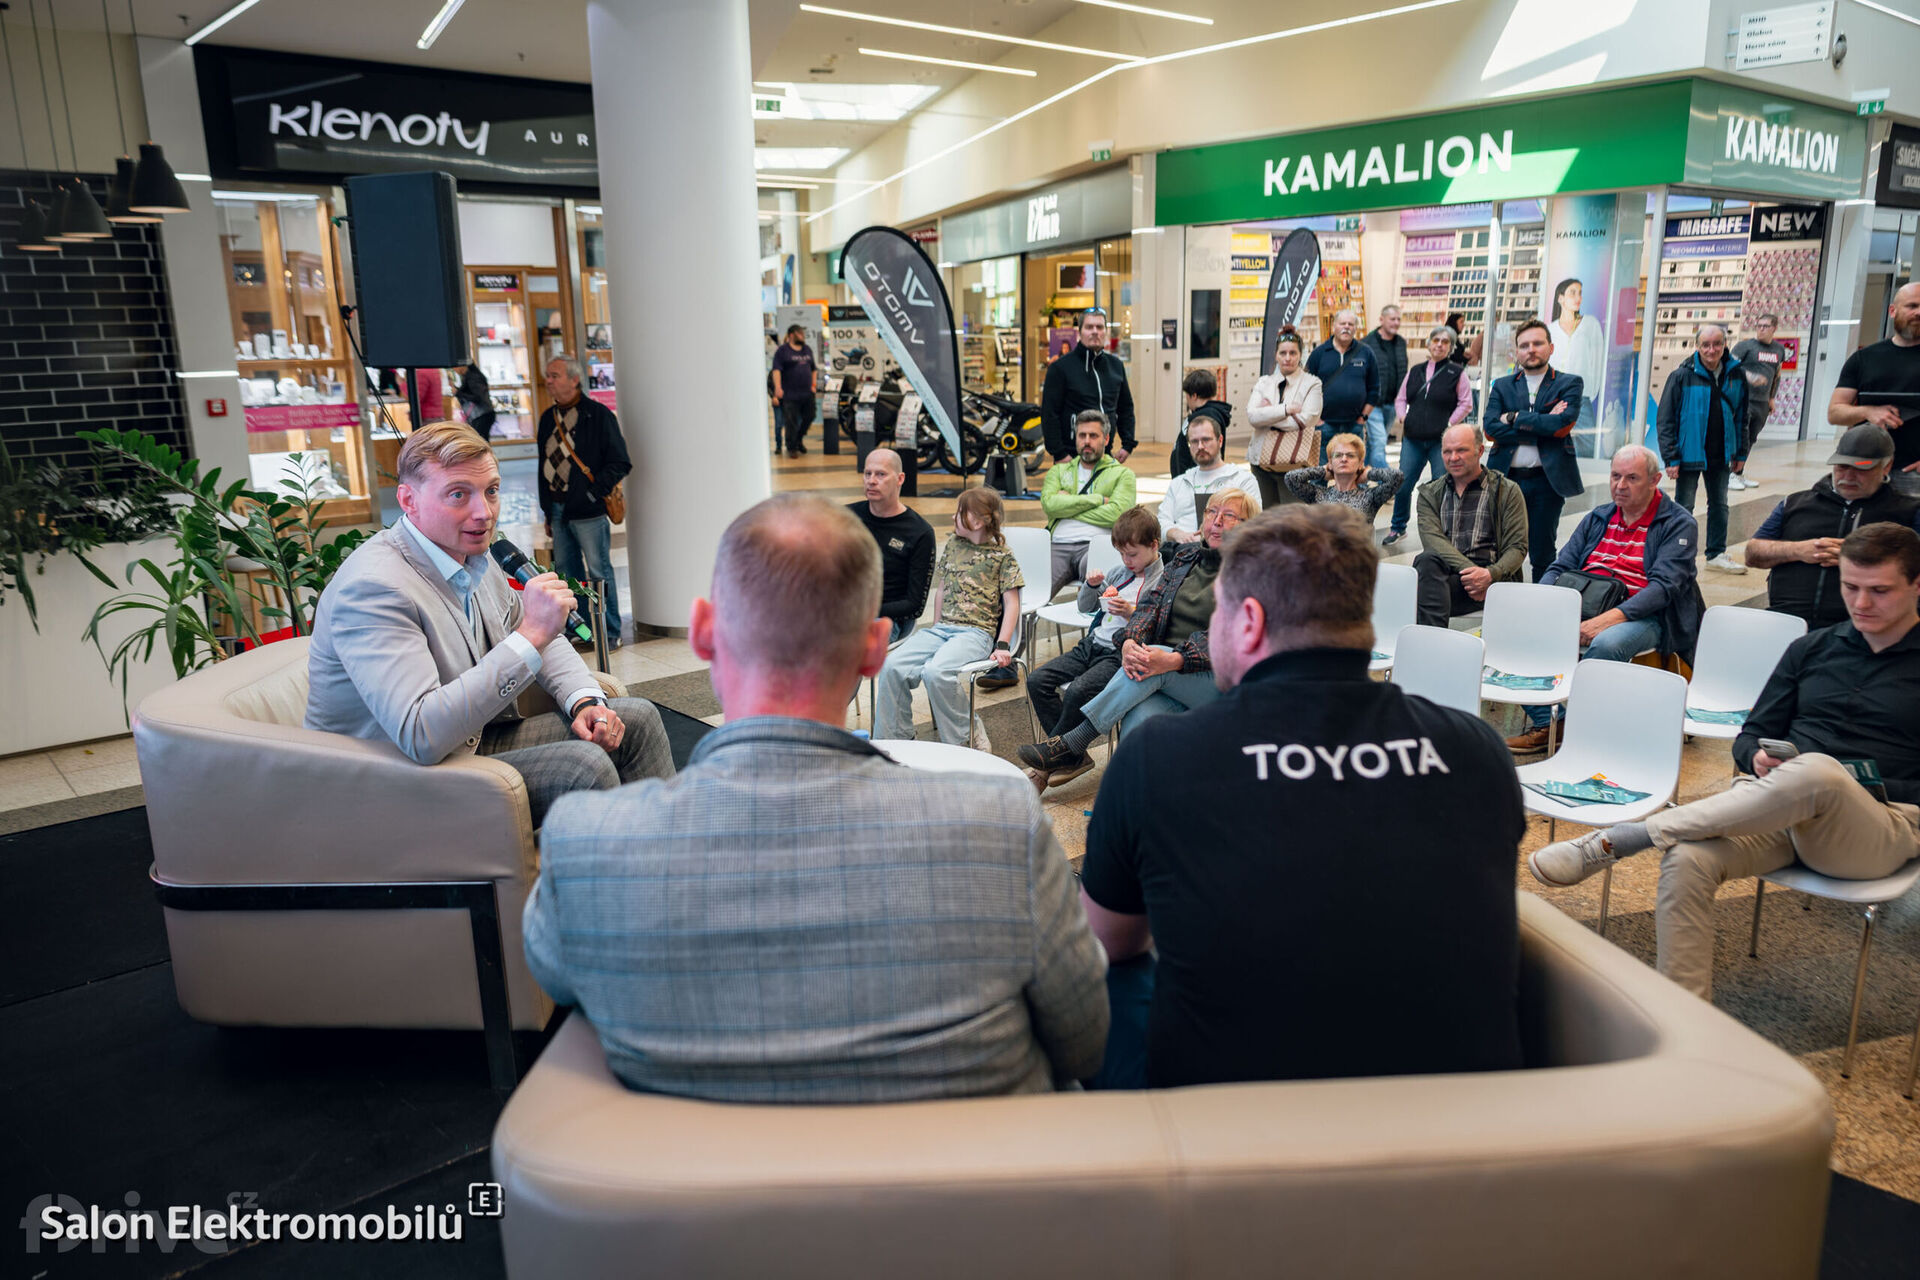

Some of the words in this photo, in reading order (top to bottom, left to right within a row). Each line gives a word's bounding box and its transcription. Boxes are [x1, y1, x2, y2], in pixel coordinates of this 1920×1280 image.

[1725, 116, 1839, 173] KAMALION
[1264, 129, 1514, 196] KAMALION
[1679, 216, 1743, 236] MAGSAFE
[1760, 212, 1817, 233] NEW
[1556, 229, 1607, 239] KAMALION
[1424, 259, 1432, 267] TO
[832, 330, 853, 339] 100
[1242, 737, 1450, 781] TOYOTA
